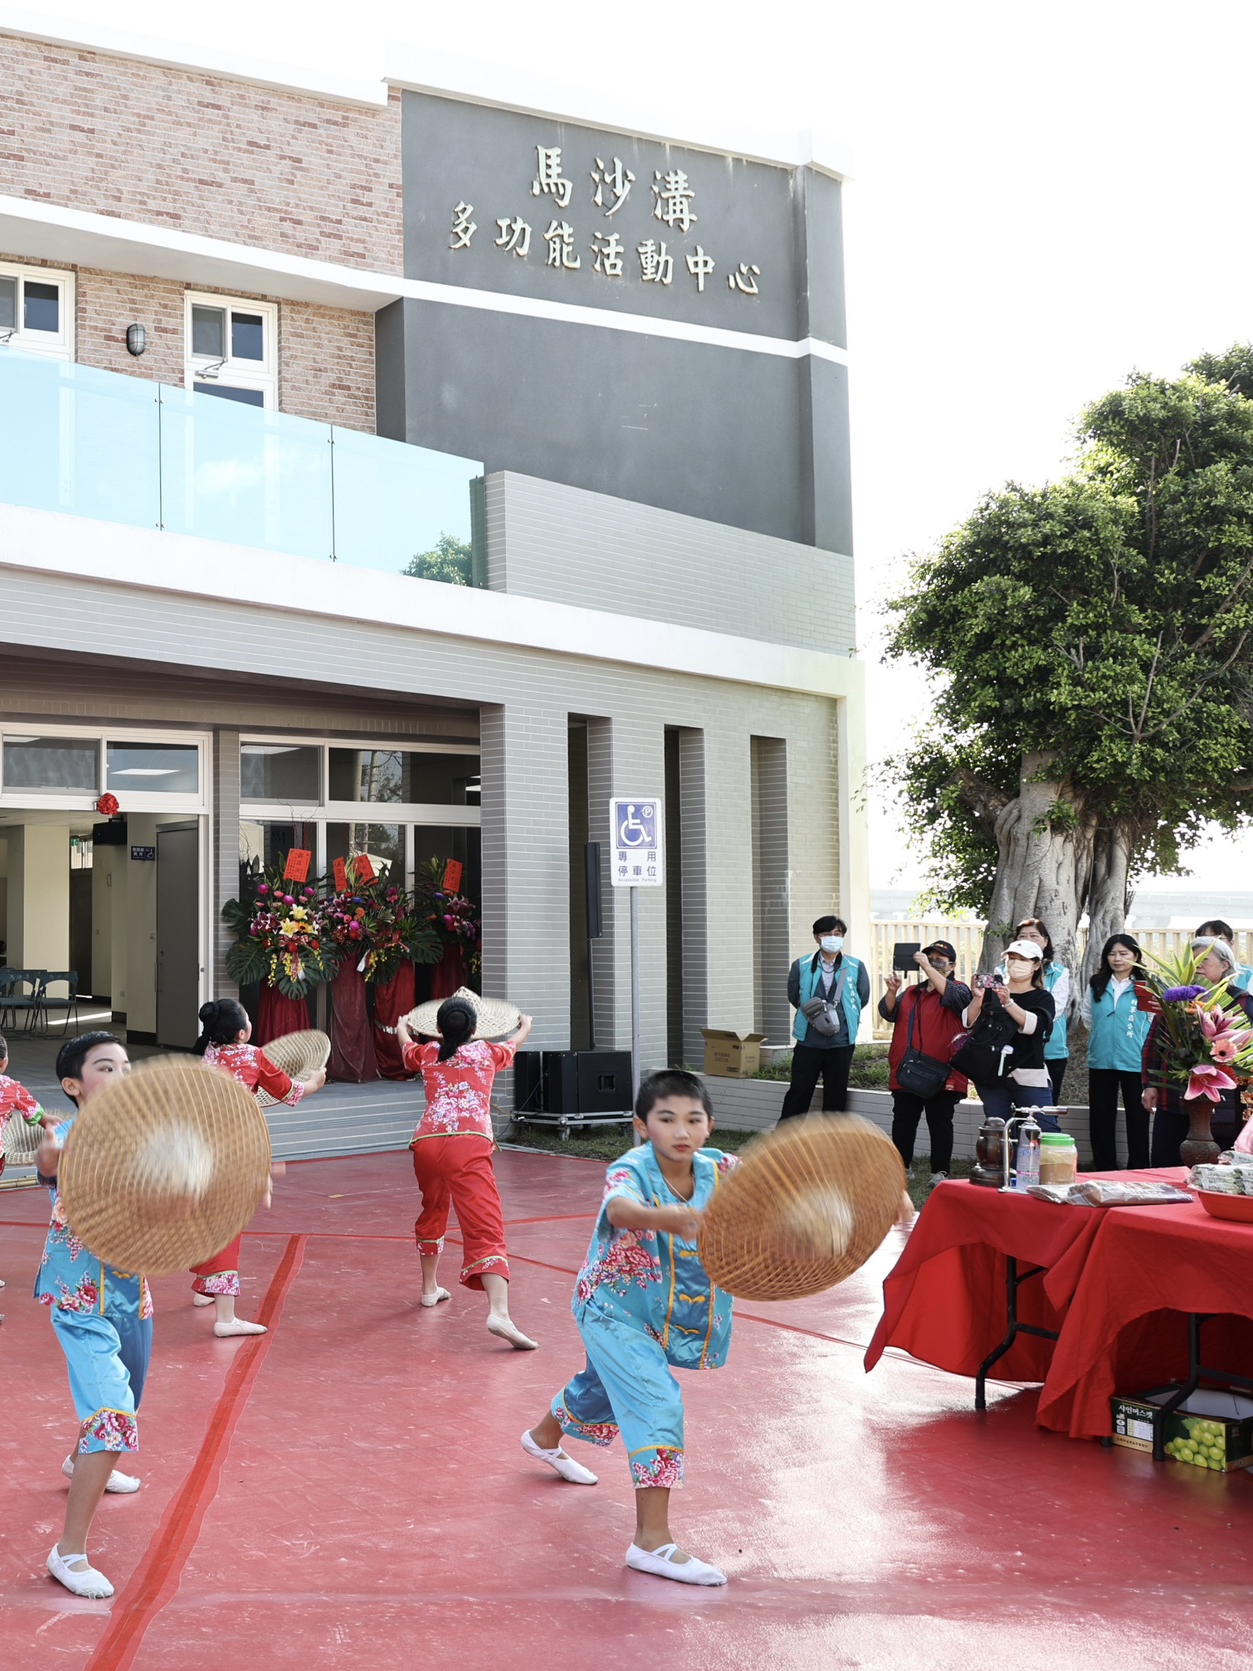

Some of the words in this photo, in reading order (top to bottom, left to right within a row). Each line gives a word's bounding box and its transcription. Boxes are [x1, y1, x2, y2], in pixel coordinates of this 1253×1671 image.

[530, 144, 698, 233] 馬沙溝
[449, 199, 762, 296] 多功能活動中心
[618, 851, 657, 862] 專用
[618, 865, 657, 877] 停車位
